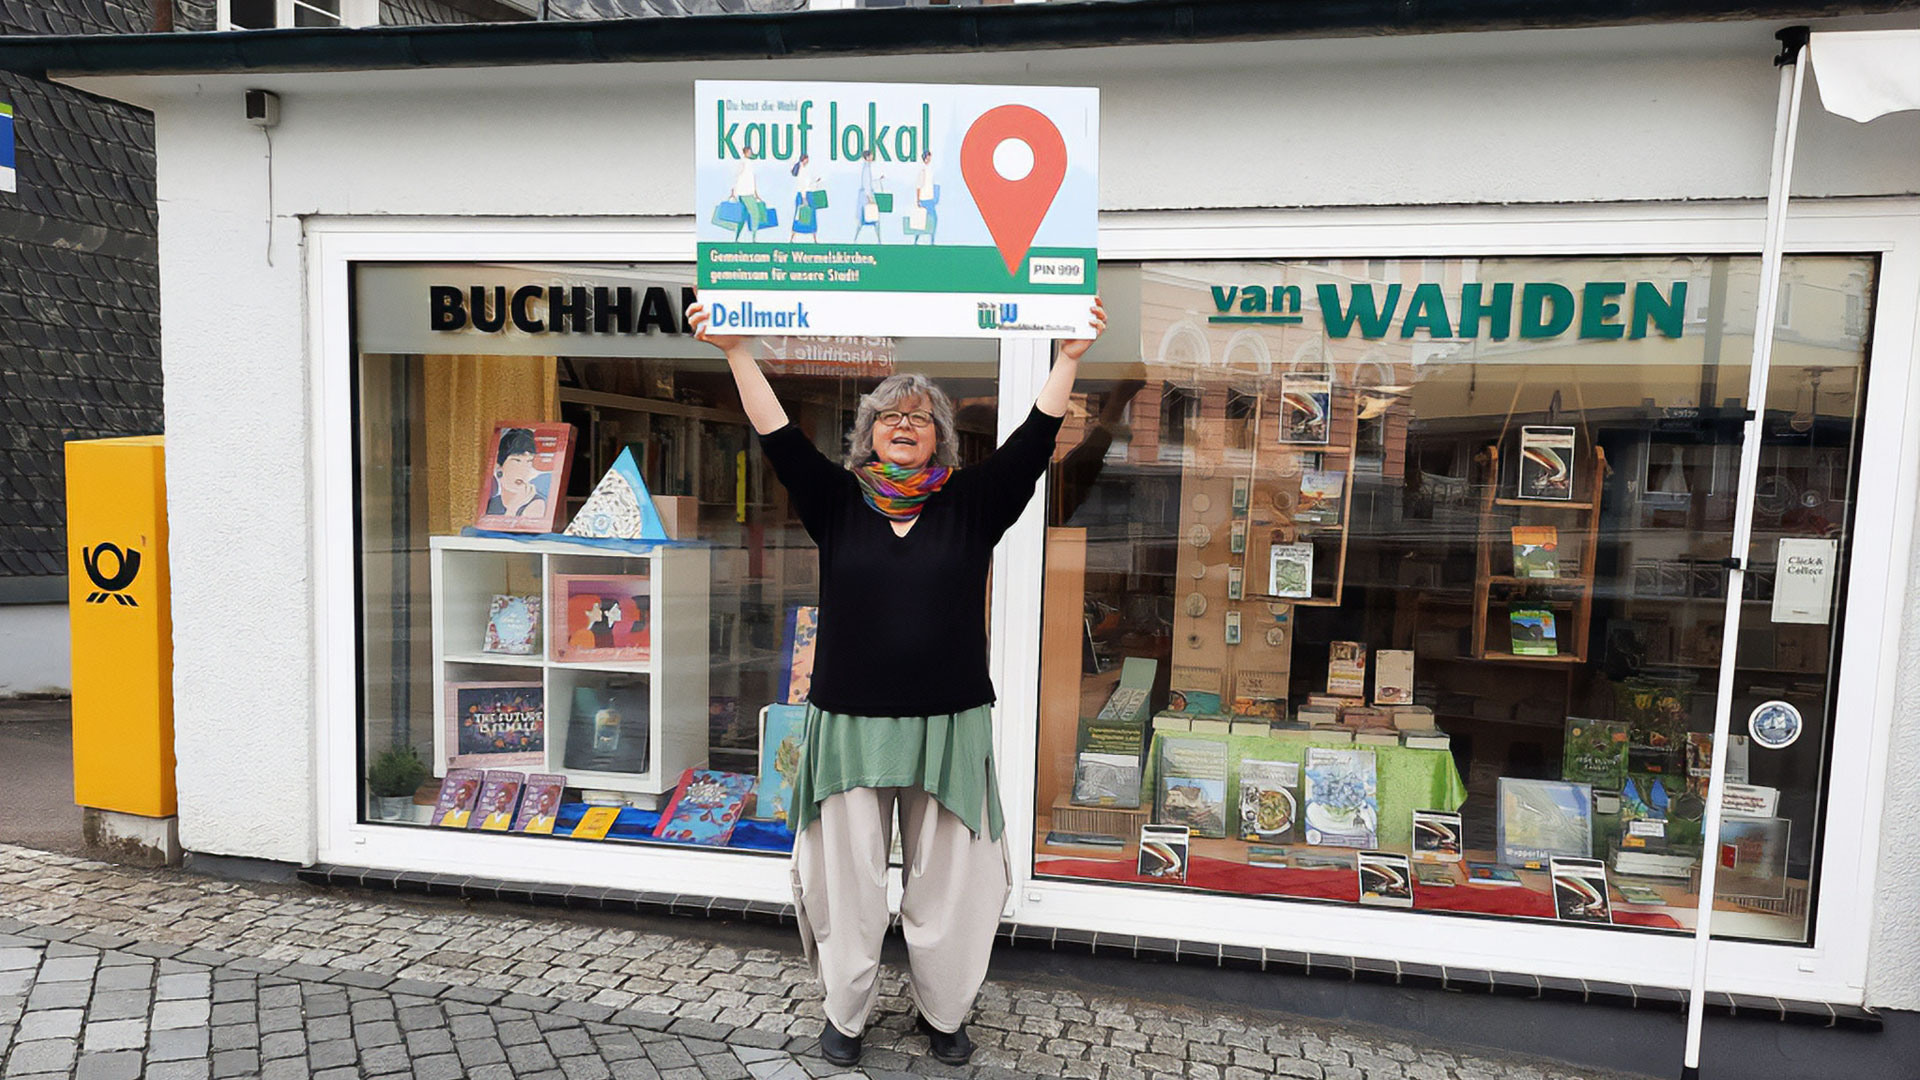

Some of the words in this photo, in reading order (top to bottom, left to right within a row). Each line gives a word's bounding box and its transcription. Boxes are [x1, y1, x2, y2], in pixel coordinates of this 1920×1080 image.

[717, 100, 813, 160] kauf
[830, 101, 931, 162] lokal
[710, 250, 770, 263] Gemeinsam
[773, 250, 788, 263] für
[792, 251, 877, 265] Wermelskirchen,
[710, 269, 769, 283] gemeinsam
[771, 268, 787, 281] für
[790, 272, 824, 281] unsere
[828, 269, 860, 282] Stadt!
[1034, 264, 1055, 275] PIN
[1058, 264, 1080, 276] 999
[712, 301, 810, 328] Dellmark
[1210, 284, 1301, 314] van
[1317, 281, 1688, 342] WAHDEN
